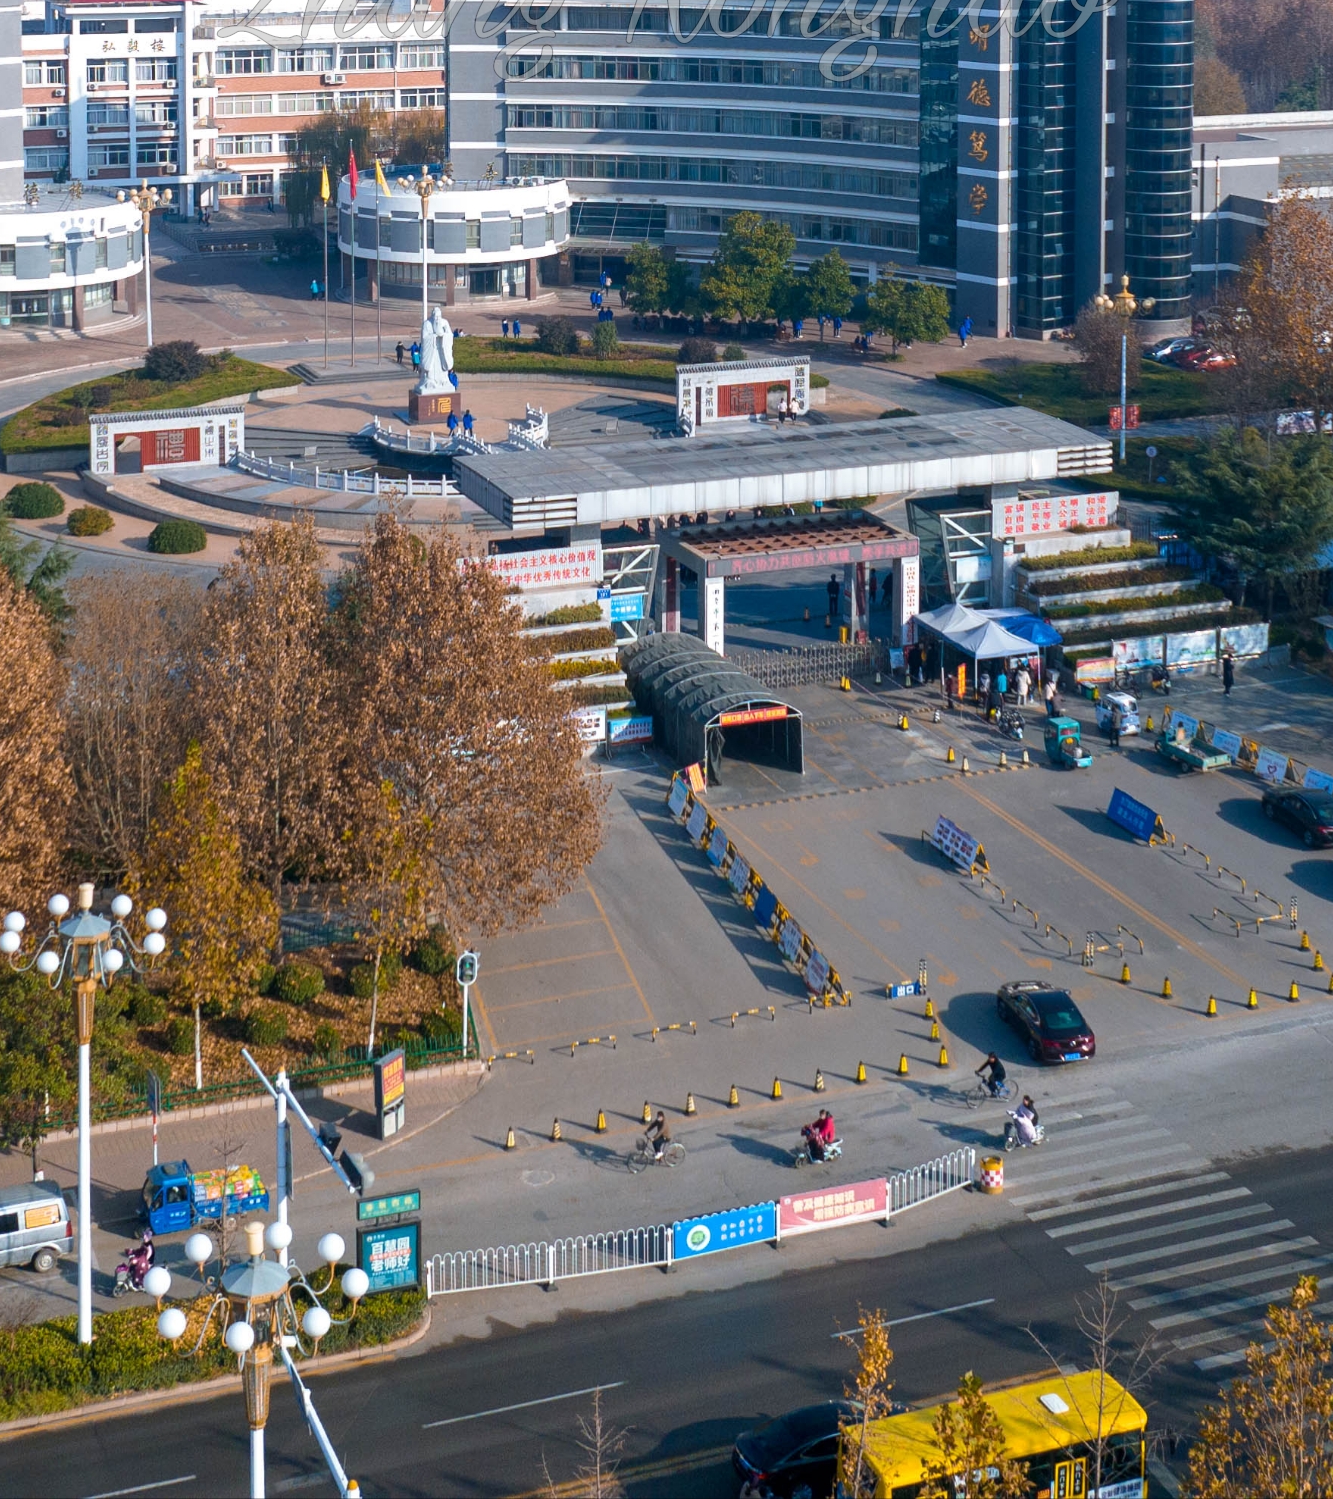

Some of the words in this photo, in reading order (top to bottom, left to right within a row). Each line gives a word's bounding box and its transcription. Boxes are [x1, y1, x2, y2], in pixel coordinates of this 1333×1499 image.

[793, 1190, 855, 1213] 普及健康知识
